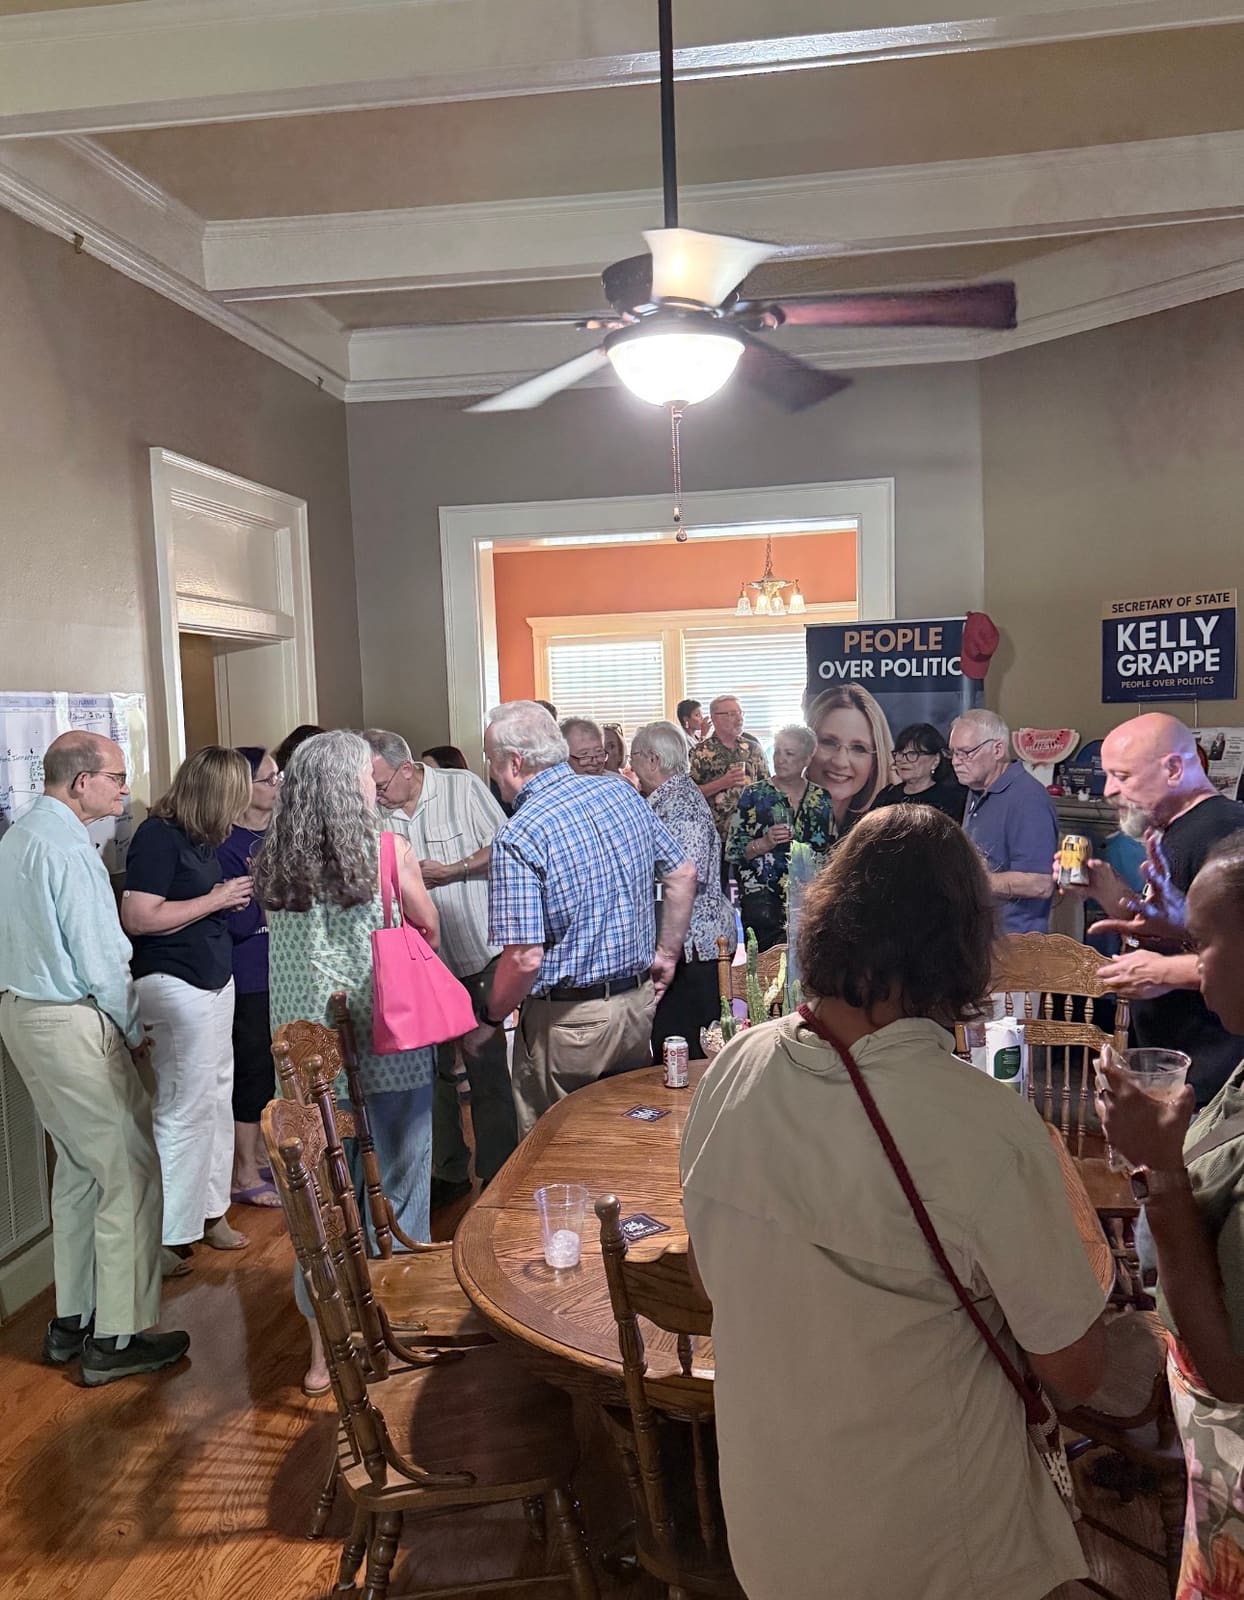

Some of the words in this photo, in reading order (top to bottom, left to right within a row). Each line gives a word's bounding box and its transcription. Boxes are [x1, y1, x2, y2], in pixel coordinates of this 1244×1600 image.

[1112, 598, 1173, 613] SECRETARY
[1177, 596, 1191, 607] OF
[1196, 592, 1230, 605] STATE
[844, 627, 943, 653] PEOPLE
[1117, 615, 1220, 652] KELLY
[818, 659, 875, 679] OVER
[880, 657, 963, 678] POLITIC
[1117, 648, 1220, 677] GRAPPE
[1121, 680, 1151, 689] PEOPLE
[1152, 678, 1175, 688] OVER
[1177, 676, 1214, 686] POLITICS
